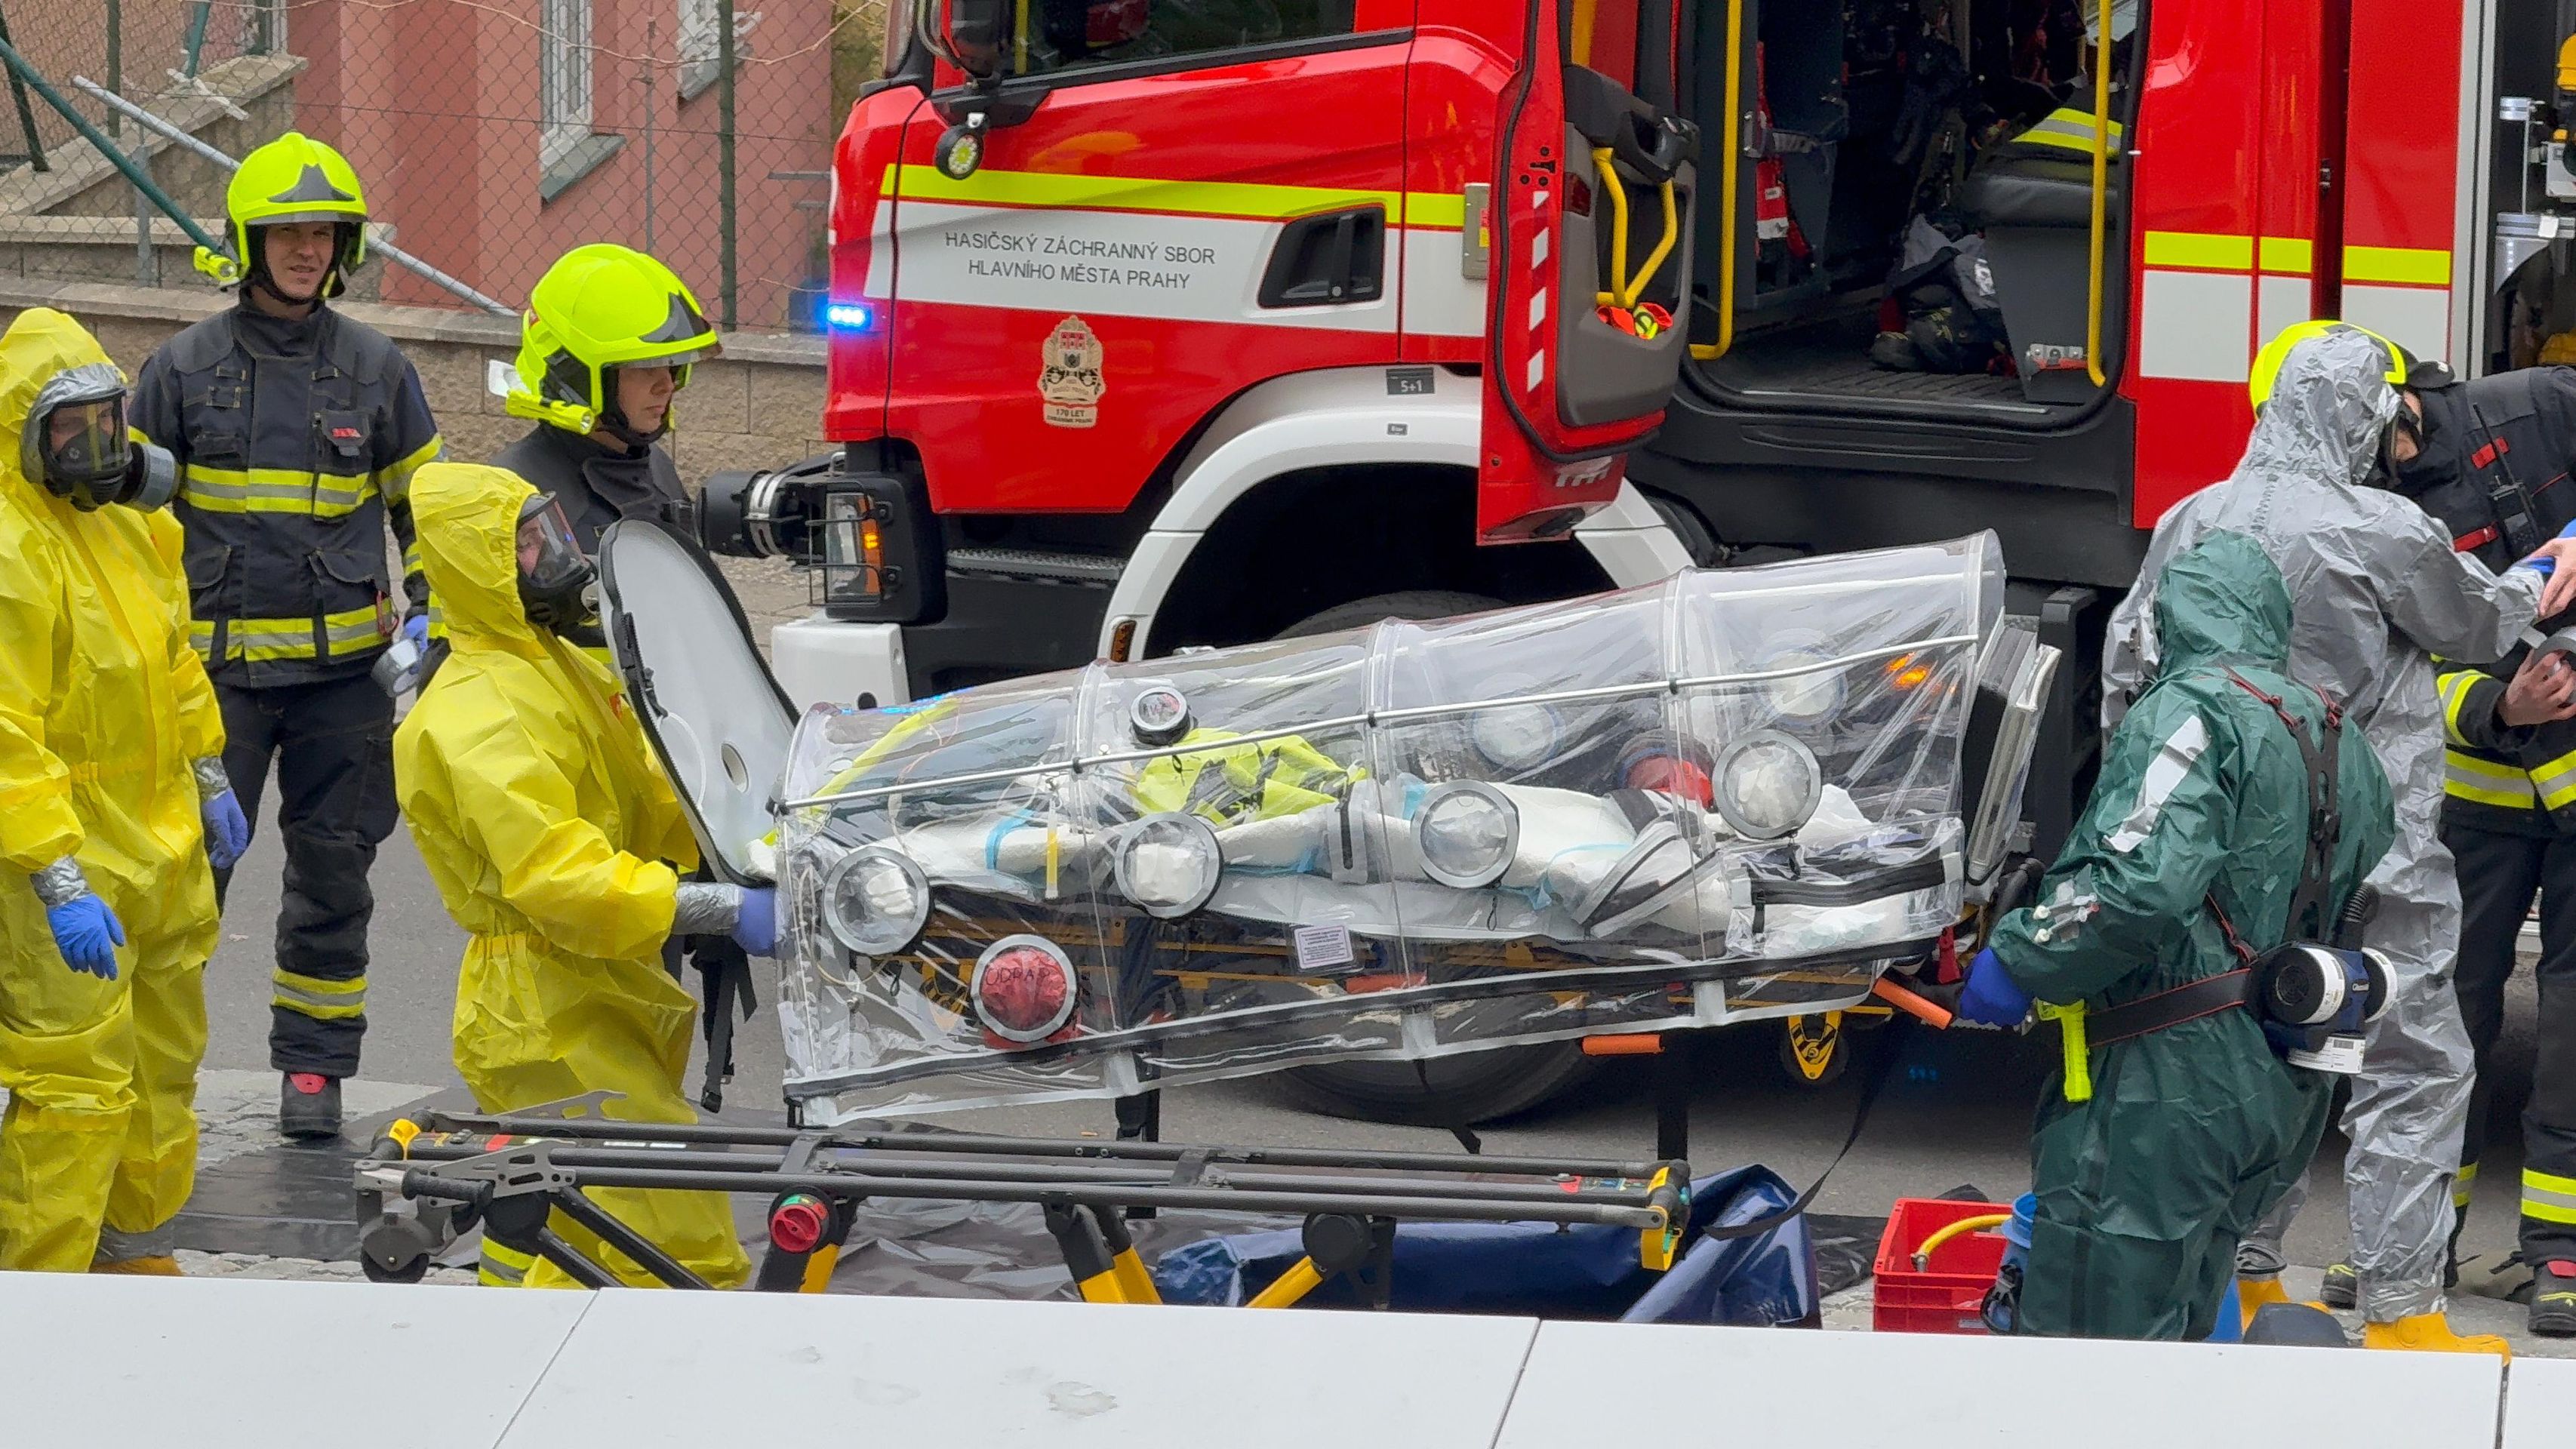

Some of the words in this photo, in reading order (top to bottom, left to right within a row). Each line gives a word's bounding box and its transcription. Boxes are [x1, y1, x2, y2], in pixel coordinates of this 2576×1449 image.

[945, 231, 1038, 252] HASIČSKÝ
[1043, 235, 1159, 260] ZÁCHRANNÝ
[1165, 246, 1215, 264] SBOR
[968, 260, 1055, 280] HLAVNÍHO
[1060, 263, 1121, 285] MĚSTA
[1127, 270, 1190, 289] PRAHY
[1400, 380, 1422, 392] 5+1
